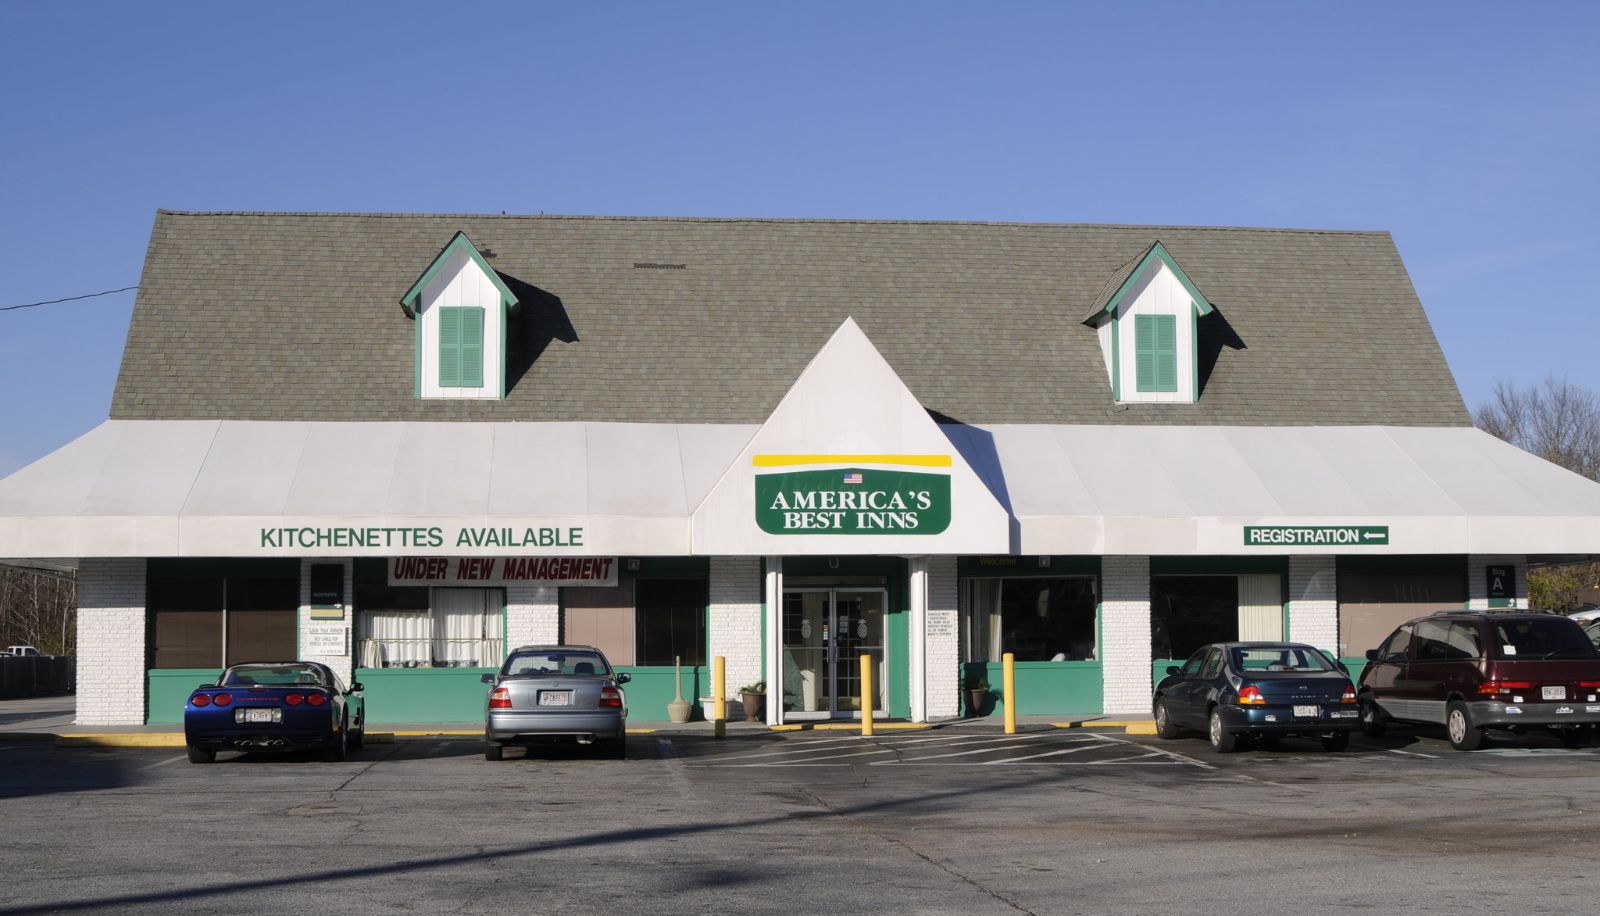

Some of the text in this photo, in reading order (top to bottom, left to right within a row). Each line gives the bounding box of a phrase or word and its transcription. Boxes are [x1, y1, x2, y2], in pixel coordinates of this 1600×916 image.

[770, 491, 931, 510] AMERICA'S
[783, 512, 918, 529] BEST INNS
[261, 527, 584, 548] KITCHENETTES AVAILABLE
[1250, 528, 1360, 543] REGISTRATION
[394, 557, 613, 580] UNDER NEW MANAGEMENT
[1492, 577, 1503, 590] A
